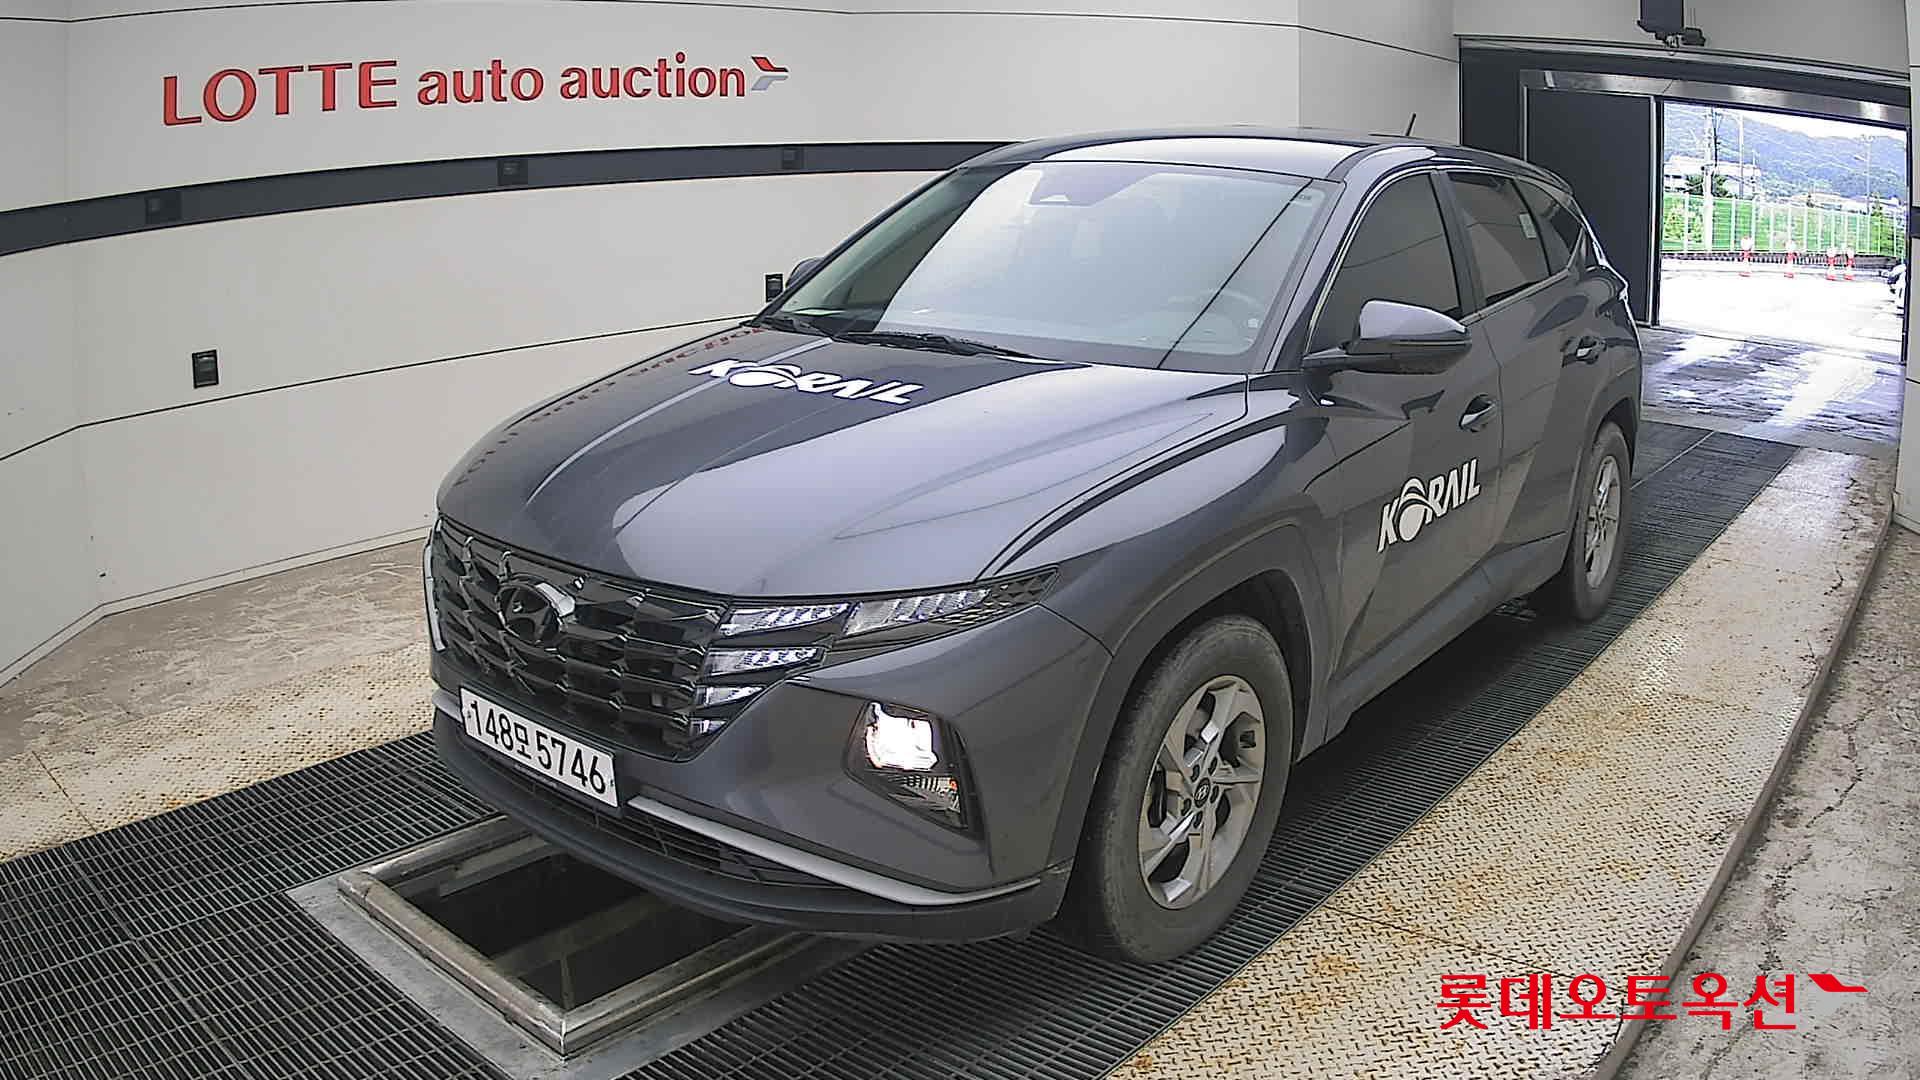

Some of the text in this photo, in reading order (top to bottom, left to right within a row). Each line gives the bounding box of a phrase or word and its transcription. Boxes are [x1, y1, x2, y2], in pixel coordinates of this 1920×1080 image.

[162, 51, 747, 126] LOTTE auto auction
[688, 358, 924, 405] KORAIL
[1377, 457, 1482, 553] KORAIL
